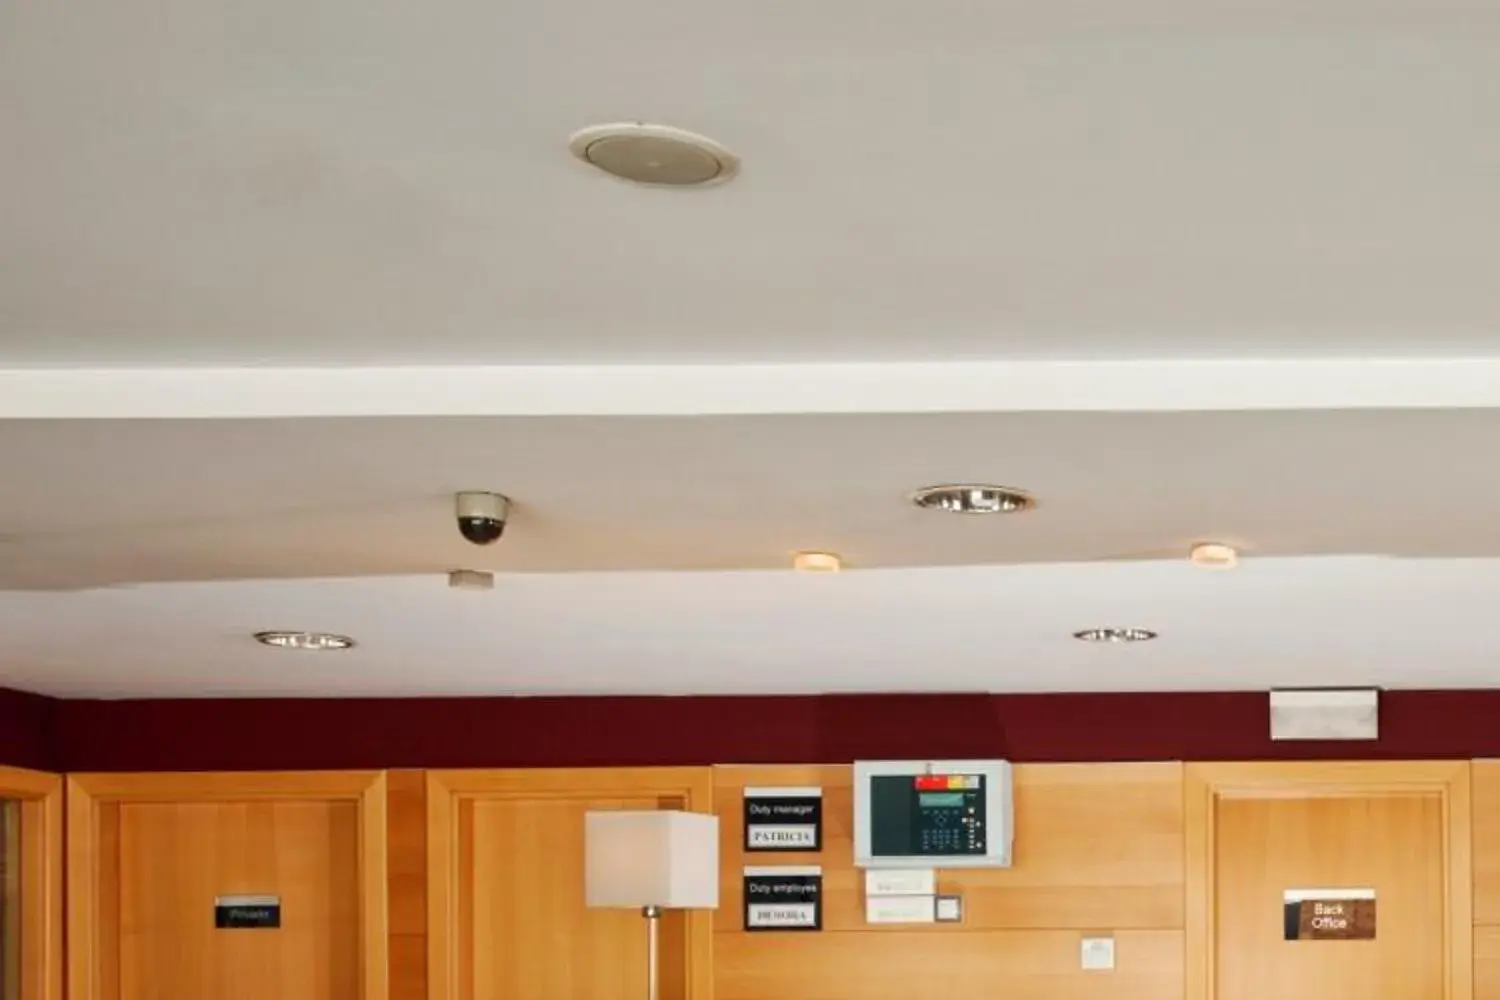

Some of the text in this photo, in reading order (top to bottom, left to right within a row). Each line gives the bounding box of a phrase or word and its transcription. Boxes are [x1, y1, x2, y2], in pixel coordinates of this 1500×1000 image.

[749, 802, 815, 816] Duty manager
[754, 831, 810, 841] PATRICIA
[749, 882, 817, 895] Duty employee
[1313, 902, 1344, 915] Back
[1311, 917, 1347, 929] Office
